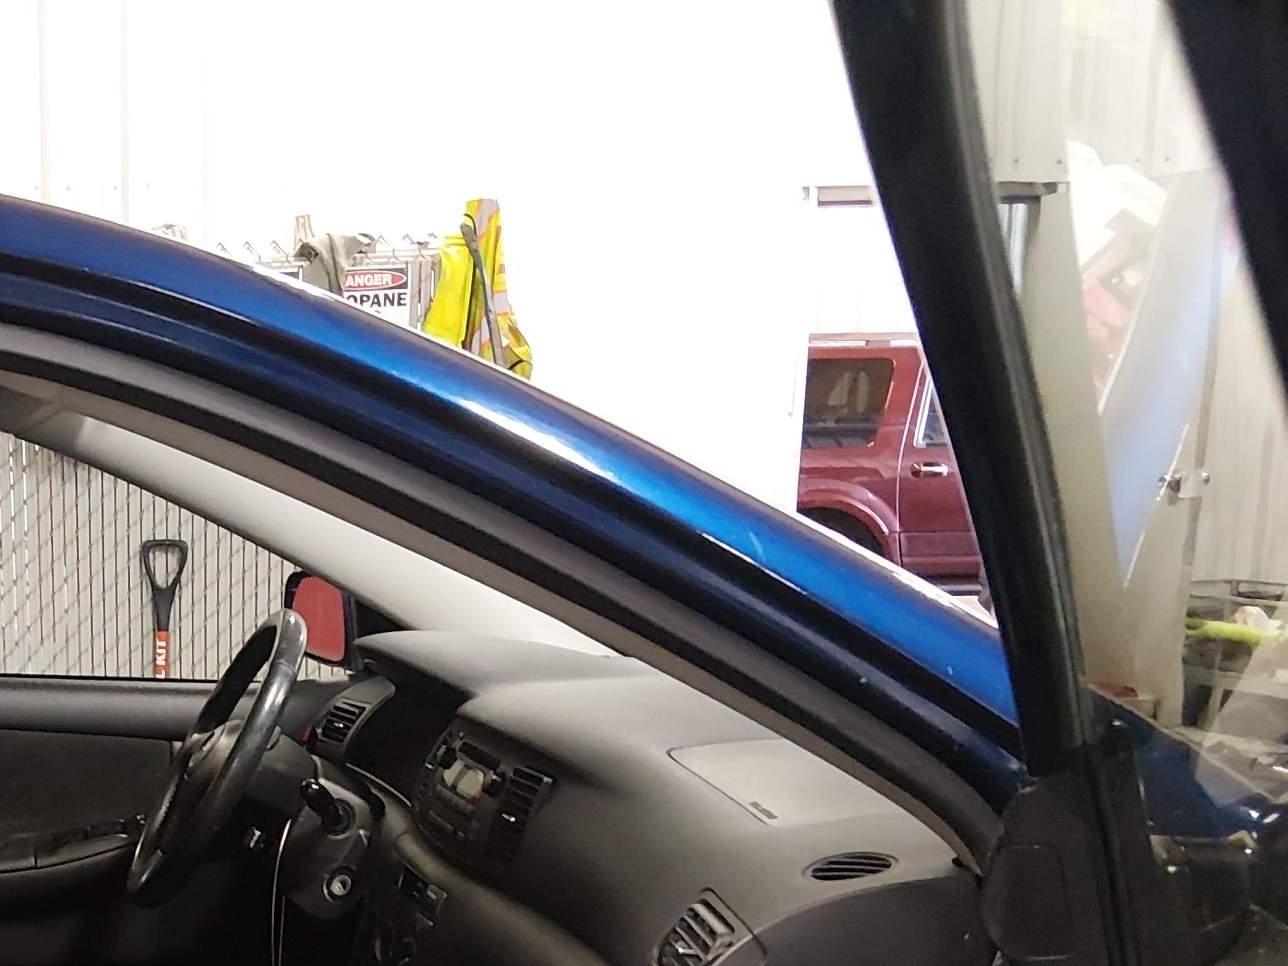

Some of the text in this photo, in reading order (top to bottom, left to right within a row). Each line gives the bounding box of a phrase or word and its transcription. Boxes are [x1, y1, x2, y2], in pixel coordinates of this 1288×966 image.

[345, 273, 392, 287] ANGER
[346, 292, 407, 307] OPANE
[155, 637, 166, 665] KIT
